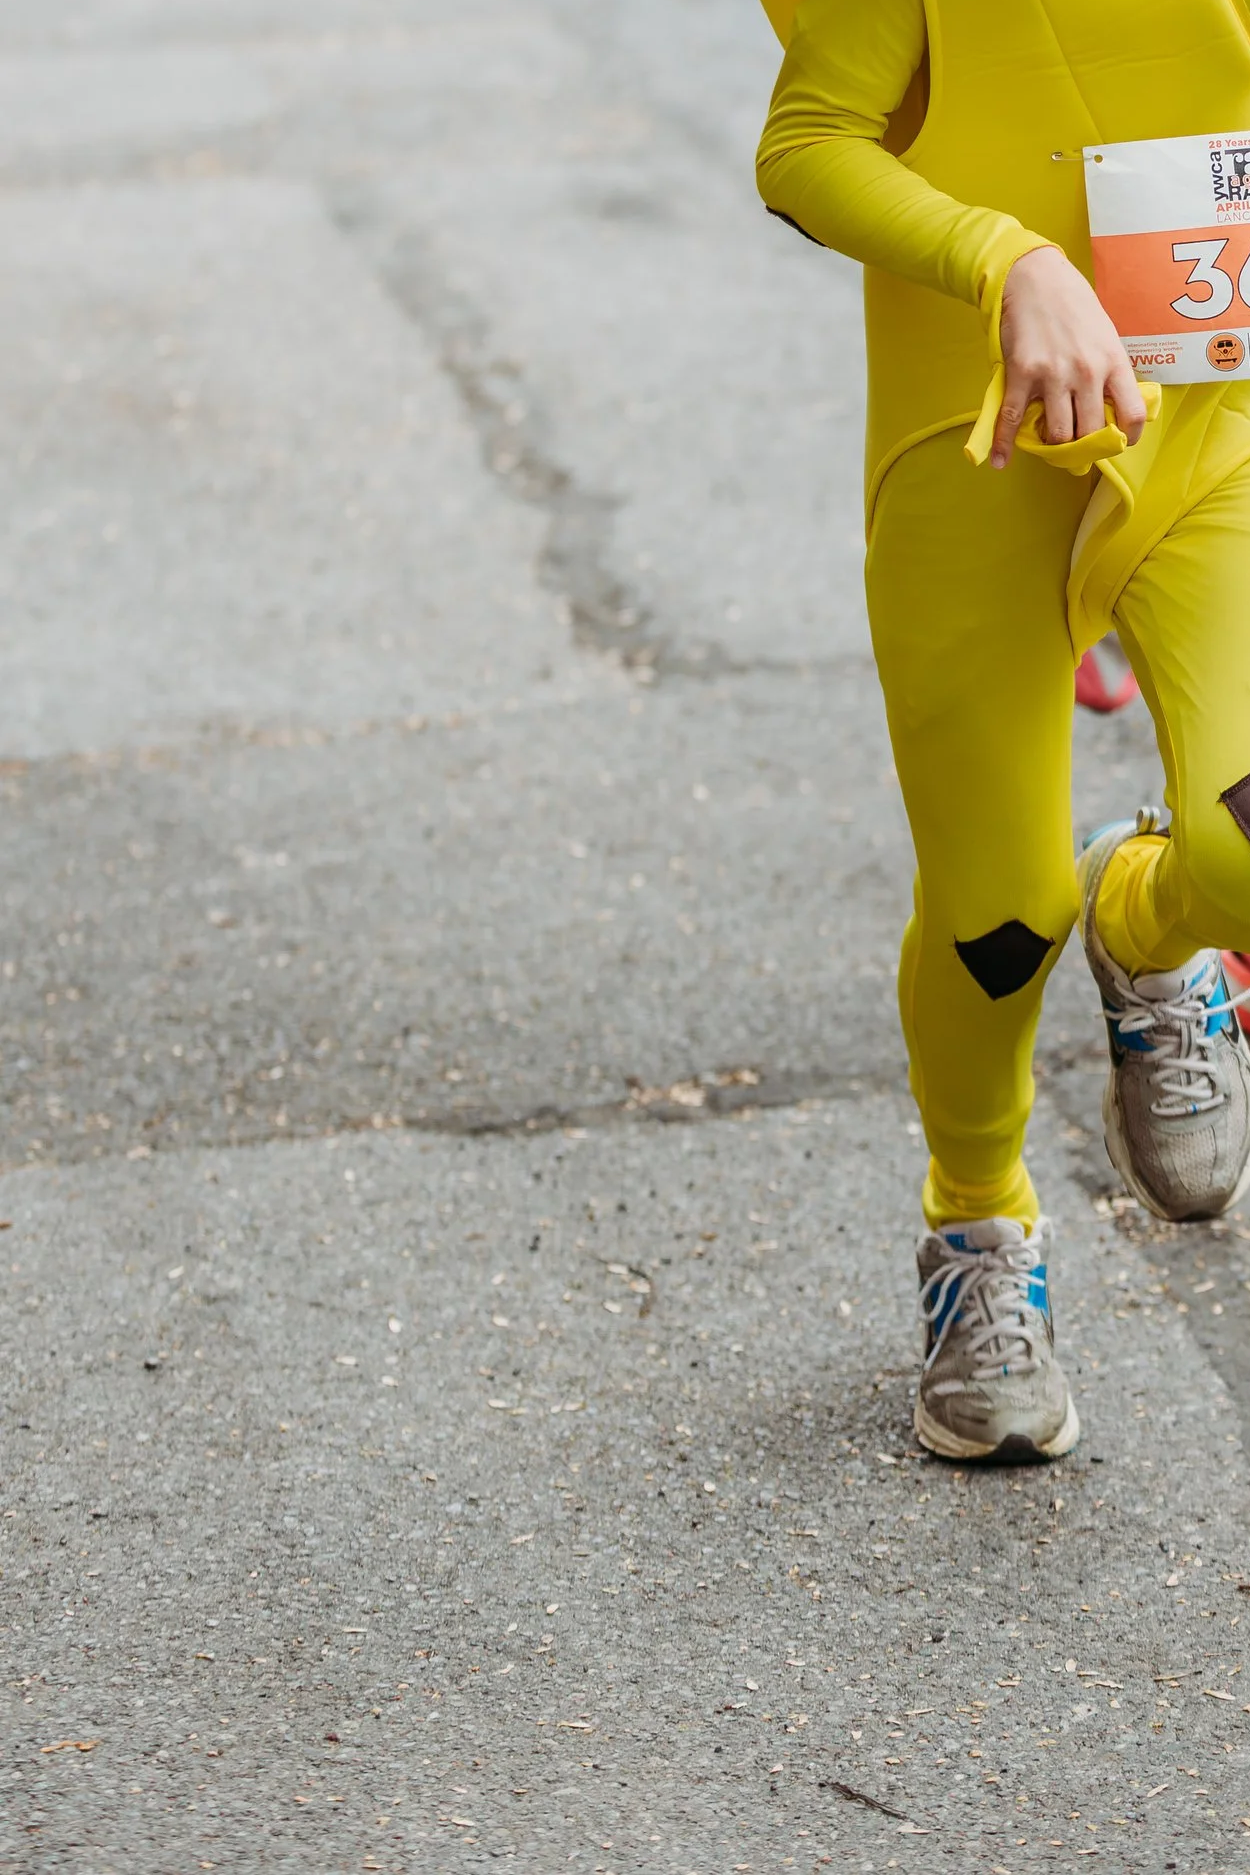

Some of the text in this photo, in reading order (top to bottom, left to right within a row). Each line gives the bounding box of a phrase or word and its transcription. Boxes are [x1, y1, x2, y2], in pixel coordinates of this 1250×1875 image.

[1209, 140, 1222, 149] 28
[1210, 151, 1229, 202] ywca
[1129, 353, 1176, 368] ywca
